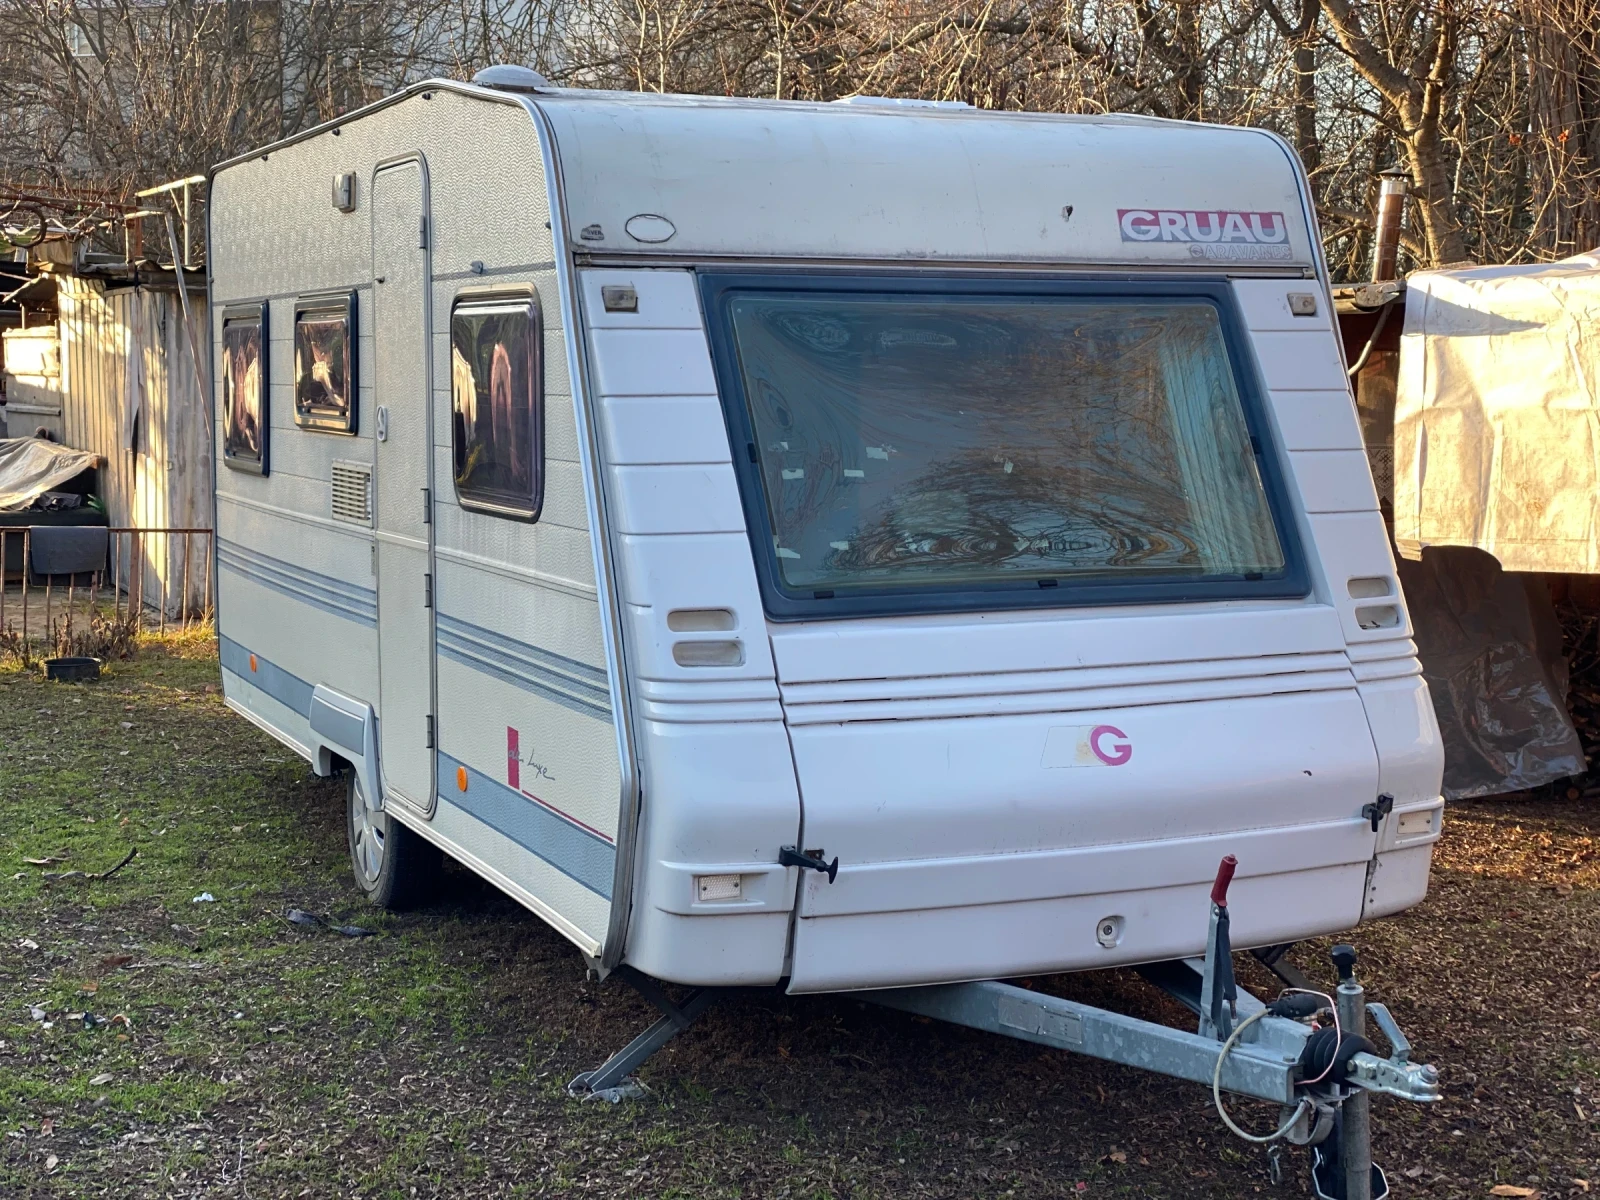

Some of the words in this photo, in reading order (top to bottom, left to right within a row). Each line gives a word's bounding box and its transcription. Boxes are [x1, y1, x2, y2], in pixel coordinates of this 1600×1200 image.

[1121, 211, 1286, 243] GRUAU
[1190, 244, 1292, 260] CARAVANES
[1090, 725, 1132, 766] G
